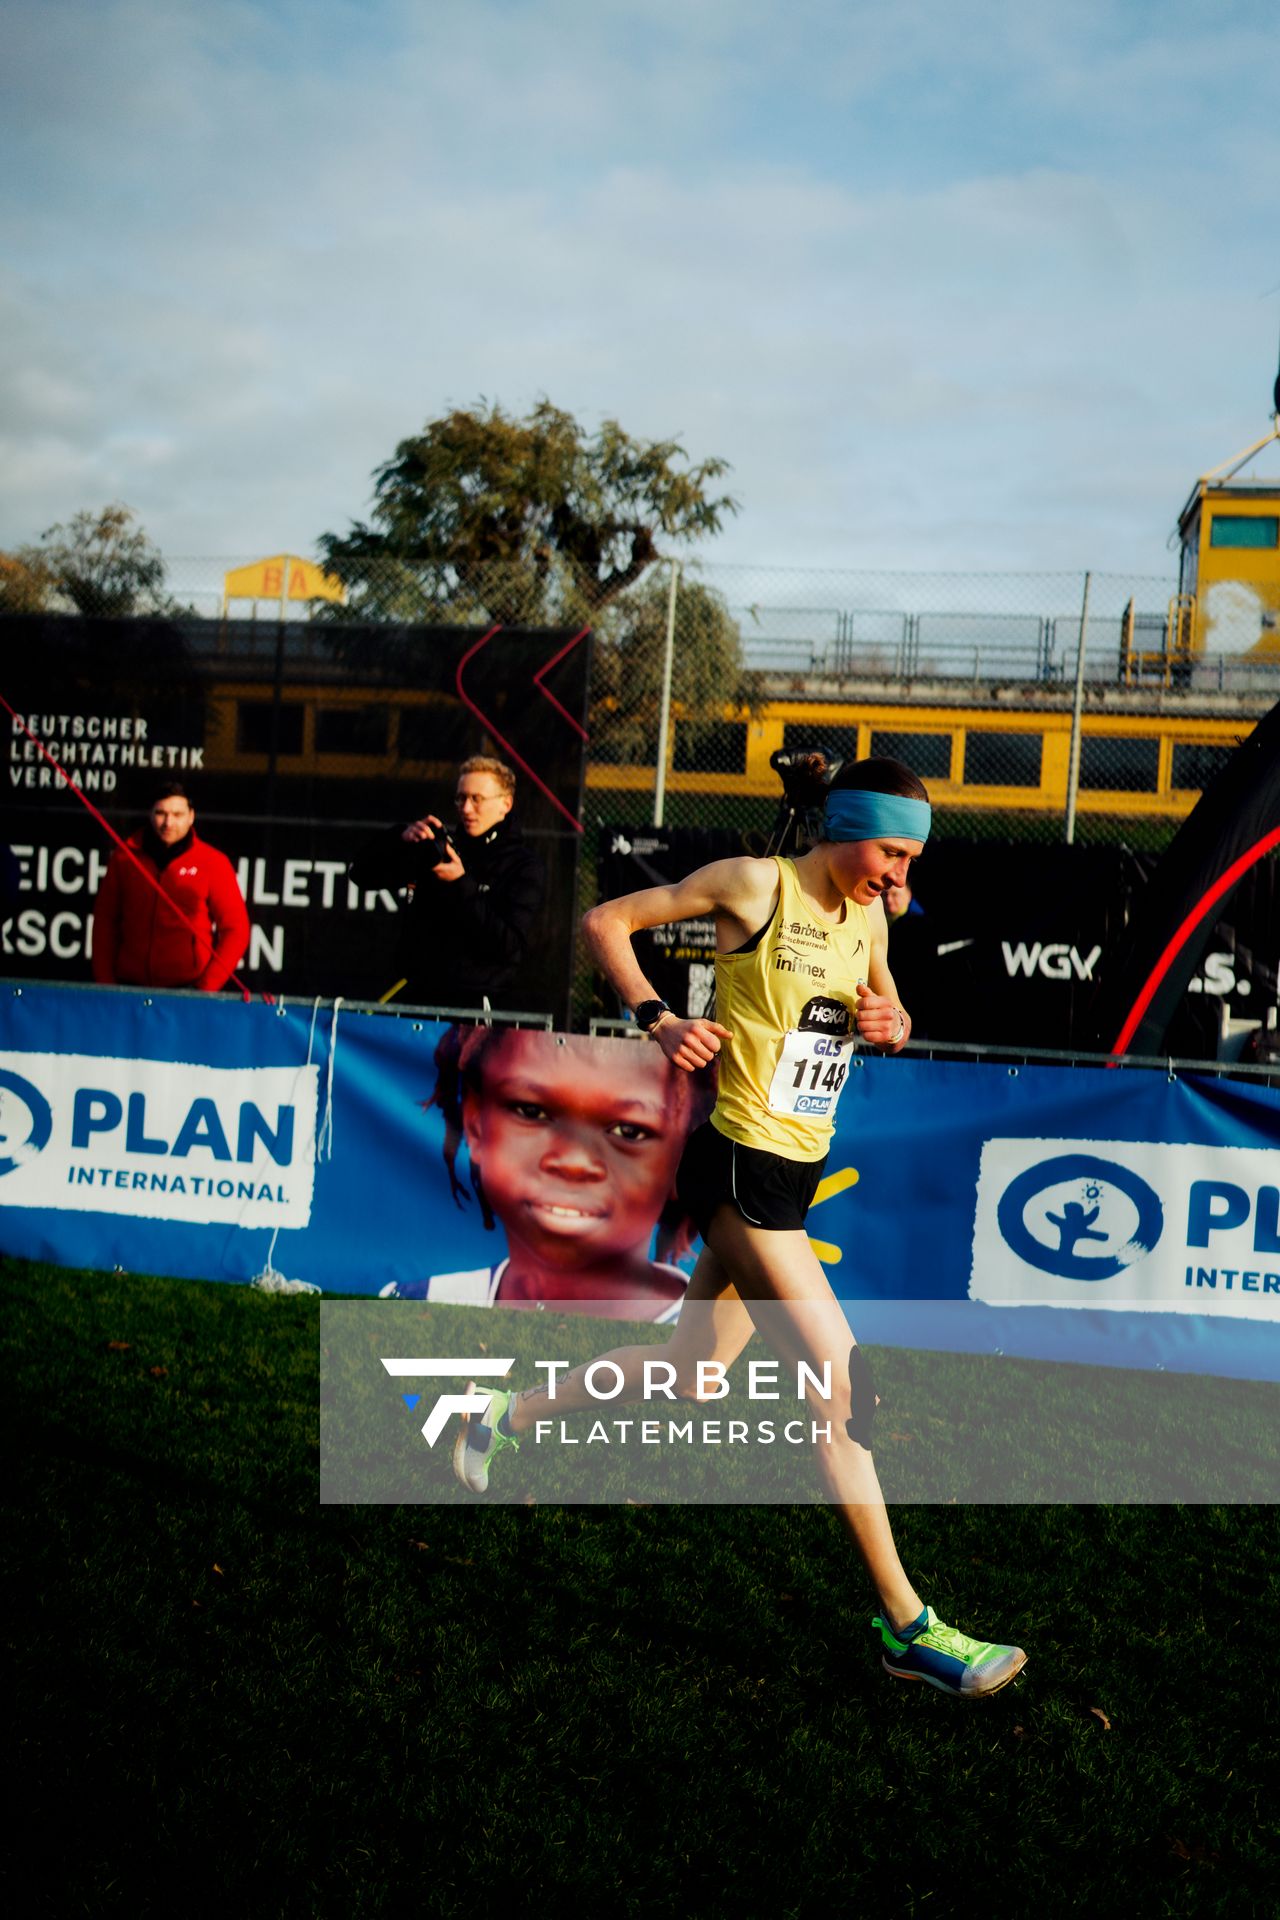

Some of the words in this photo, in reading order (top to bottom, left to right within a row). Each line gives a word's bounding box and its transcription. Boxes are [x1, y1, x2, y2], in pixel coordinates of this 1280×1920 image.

[12, 714, 148, 740] DEUTSCHER
[10, 740, 205, 770] LEICHTATHLETIK
[9, 766, 117, 792] VERBAND
[776, 953, 827, 979] infinex
[1001, 940, 1101, 981] WGV
[811, 979, 827, 989] Group
[808, 1005, 847, 1025] HOKA
[813, 1038, 843, 1058] GLS
[792, 1058, 847, 1093] 1148
[71, 1087, 296, 1168] PLAN
[1184, 1266, 1280, 1294] INTER
